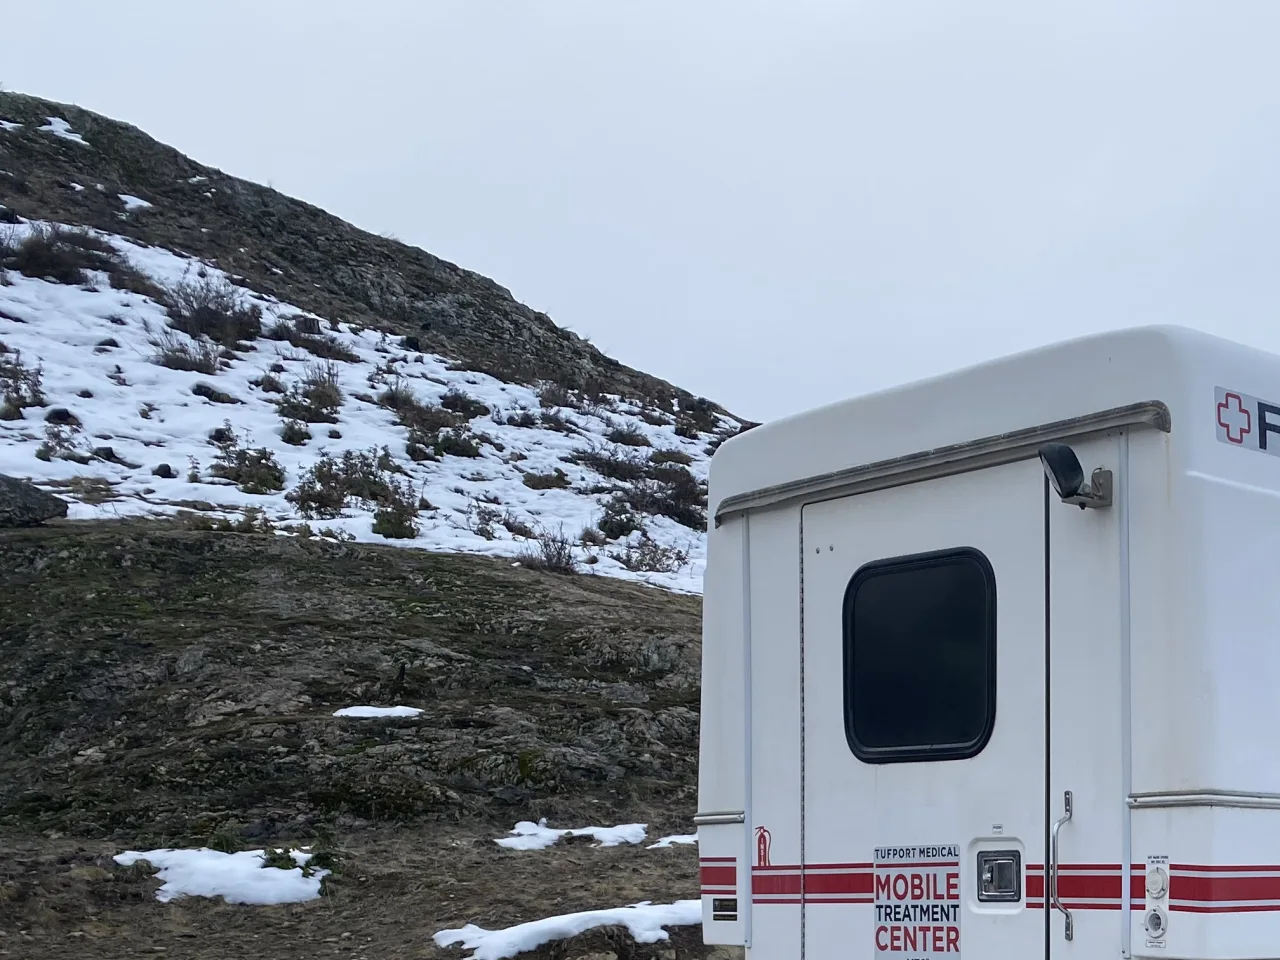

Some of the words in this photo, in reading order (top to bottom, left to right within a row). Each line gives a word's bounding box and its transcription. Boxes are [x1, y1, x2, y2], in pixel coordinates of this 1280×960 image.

[875, 848, 916, 859] TUFPORT
[918, 846, 959, 858] MEDICAL
[875, 872, 960, 901] MOBILE
[875, 904, 960, 922] TREATMENT
[875, 925, 960, 952] CENTER
